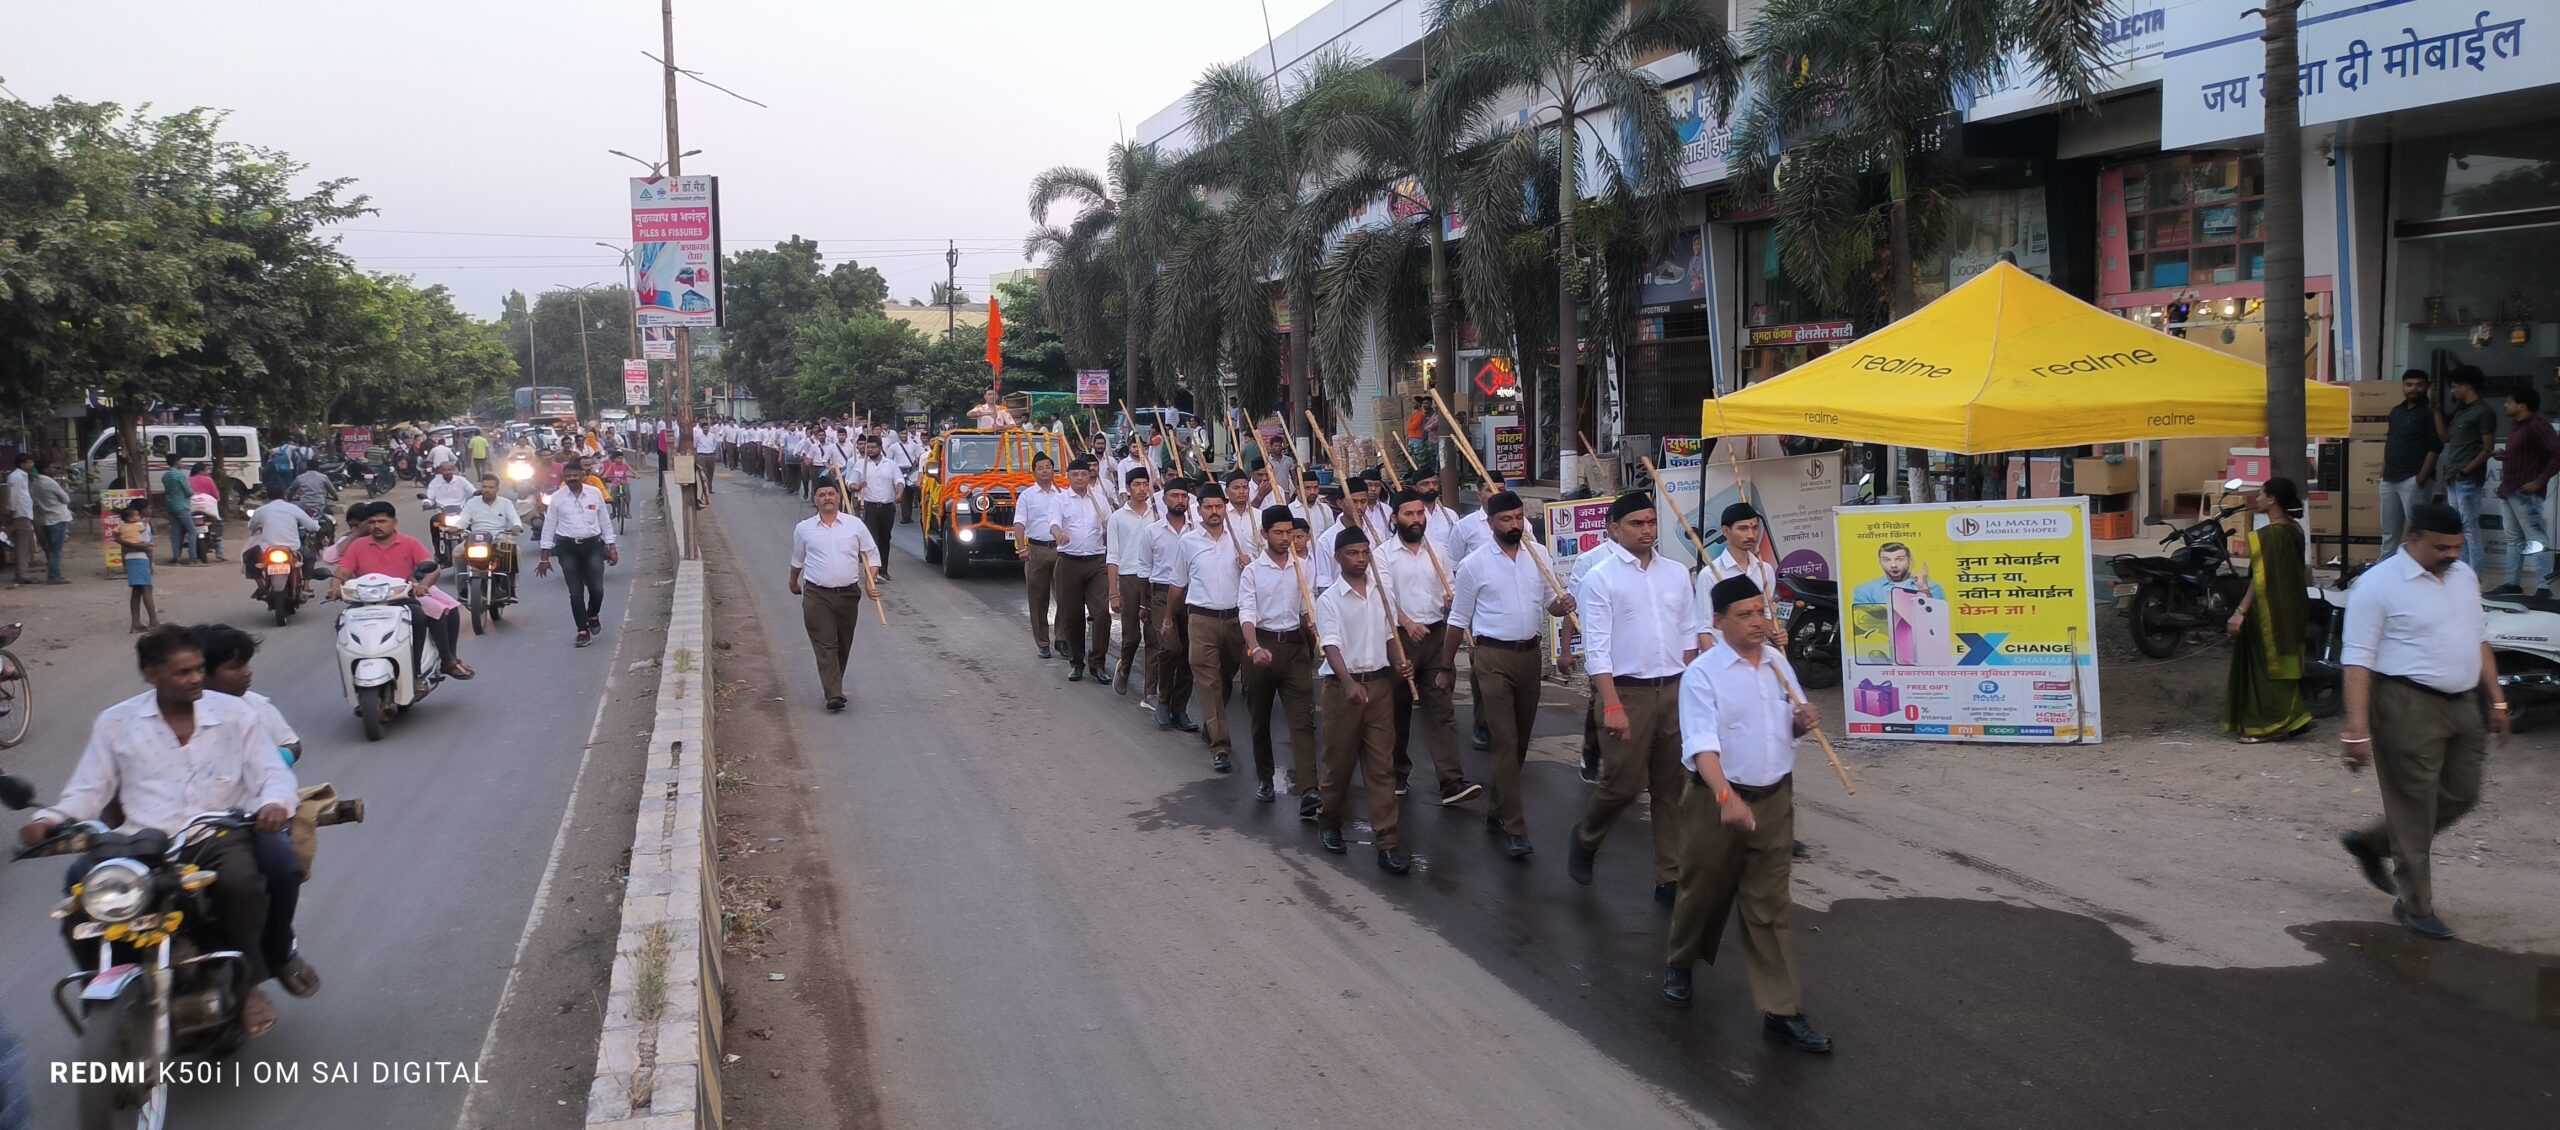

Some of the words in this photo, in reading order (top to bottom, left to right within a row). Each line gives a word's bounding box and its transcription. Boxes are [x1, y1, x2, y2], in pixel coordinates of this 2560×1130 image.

[2202, 75, 2249, 113] जय
[2336, 39, 2373, 93] दी
[2381, 10, 2526, 79] मोबाईल
[671, 213, 678, 222] व
[680, 209, 707, 224] भगंदर
[639, 229, 660, 238] PILES
[662, 228, 667, 237] &
[669, 228, 703, 237] FISSURES
[1645, 306, 1671, 314] FOOTWEAR
[1795, 327, 1829, 341] होलसेल
[1831, 323, 1853, 337] साडी
[1851, 354, 1952, 378] realme
[2032, 349, 2158, 378] realme
[1804, 412, 1839, 424] realme
[2147, 413, 2195, 426] realme
[1667, 438, 1701, 453] सुभद्रा
[1986, 520, 2001, 528] JAI
[2006, 519, 2037, 527] MATA
[2042, 518, 2057, 526] DI
[1783, 531, 1810, 542] आयफोन
[1956, 557, 1988, 571] जुना
[1993, 552, 2060, 566] मोबाईल
[1957, 571, 1997, 583] घेऊन
[2002, 572, 2028, 583] या,
[1957, 587, 2001, 599] नवीन
[2005, 585, 2074, 598] मोबाईल
[1958, 603, 1999, 616] घेऊन
[2003, 605, 2025, 615] जा
[2031, 605, 2036, 614] !
[1881, 669, 1895, 677] सर्व
